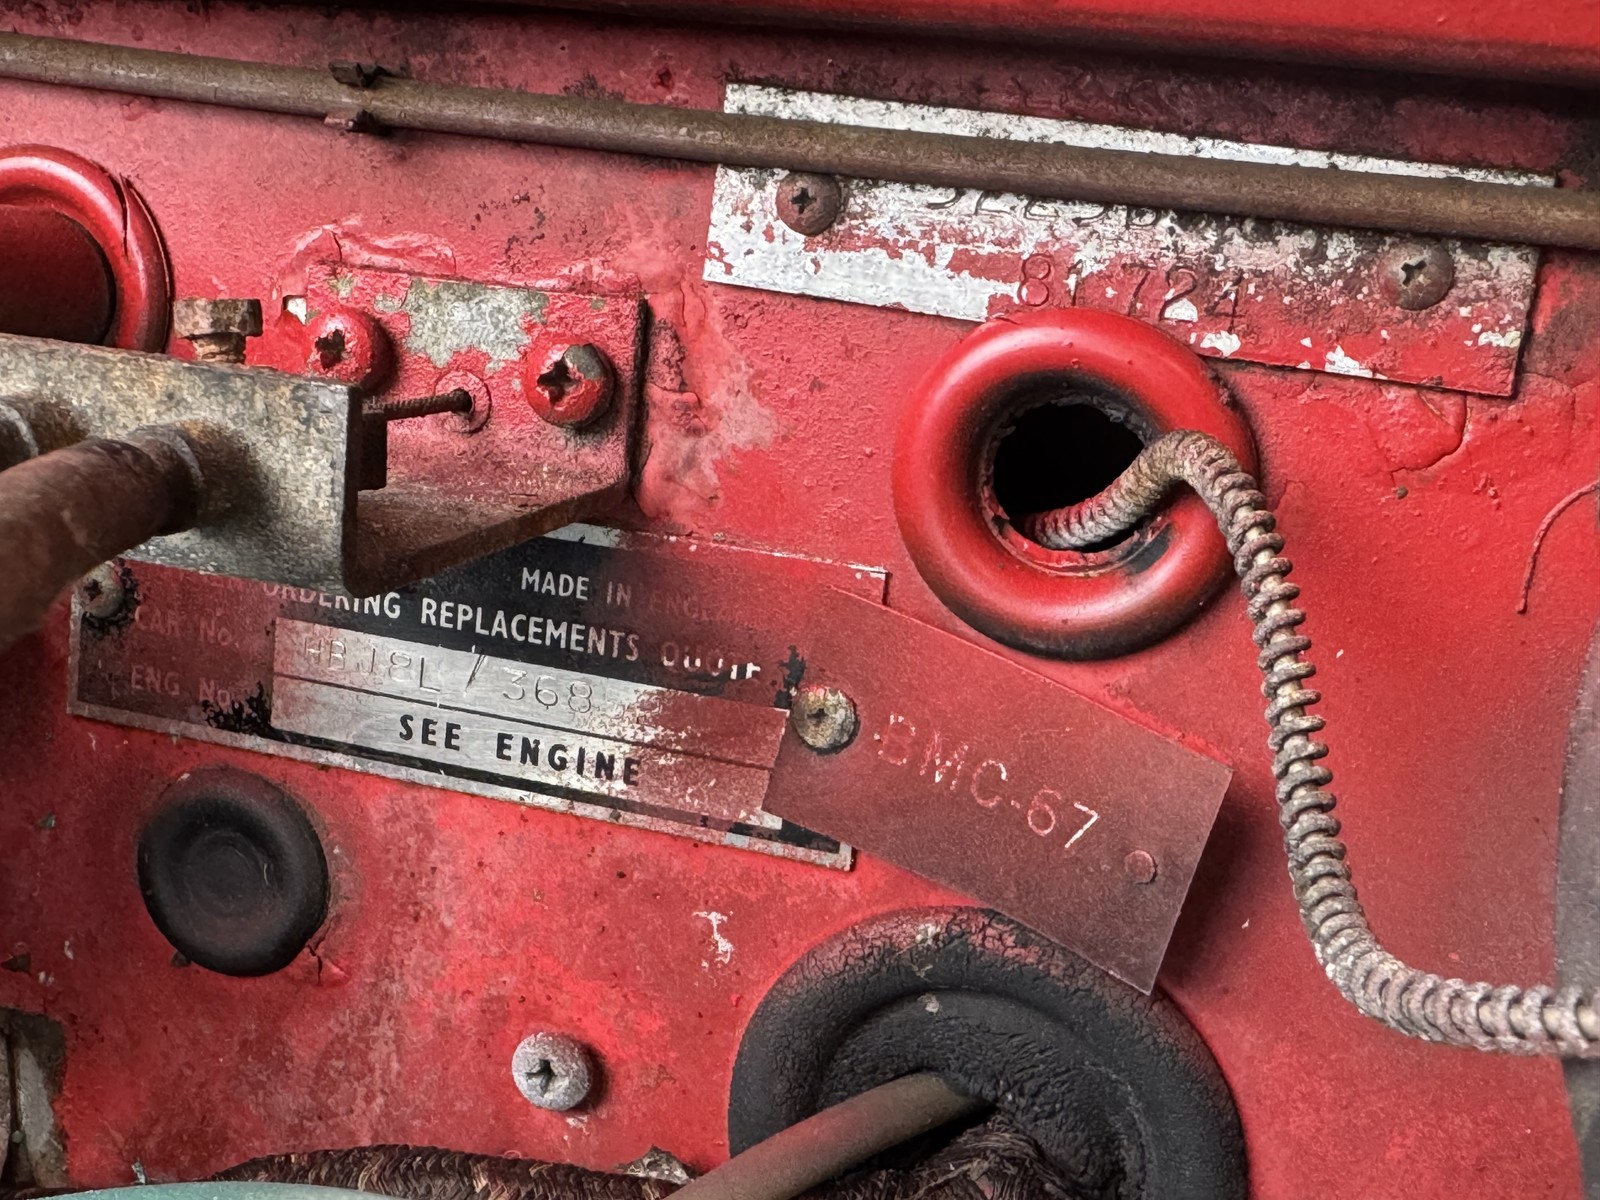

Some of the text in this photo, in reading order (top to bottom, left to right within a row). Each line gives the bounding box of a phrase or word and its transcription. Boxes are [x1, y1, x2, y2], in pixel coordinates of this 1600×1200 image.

[520, 566, 590, 601] MADE
[606, 580, 632, 608] IN
[420, 597, 640, 662] REPLACEMENTS
[130, 664, 180, 697] ENG
[398, 714, 643, 787] SEE ENGINE
[874, 713, 1100, 849] BMC-67
